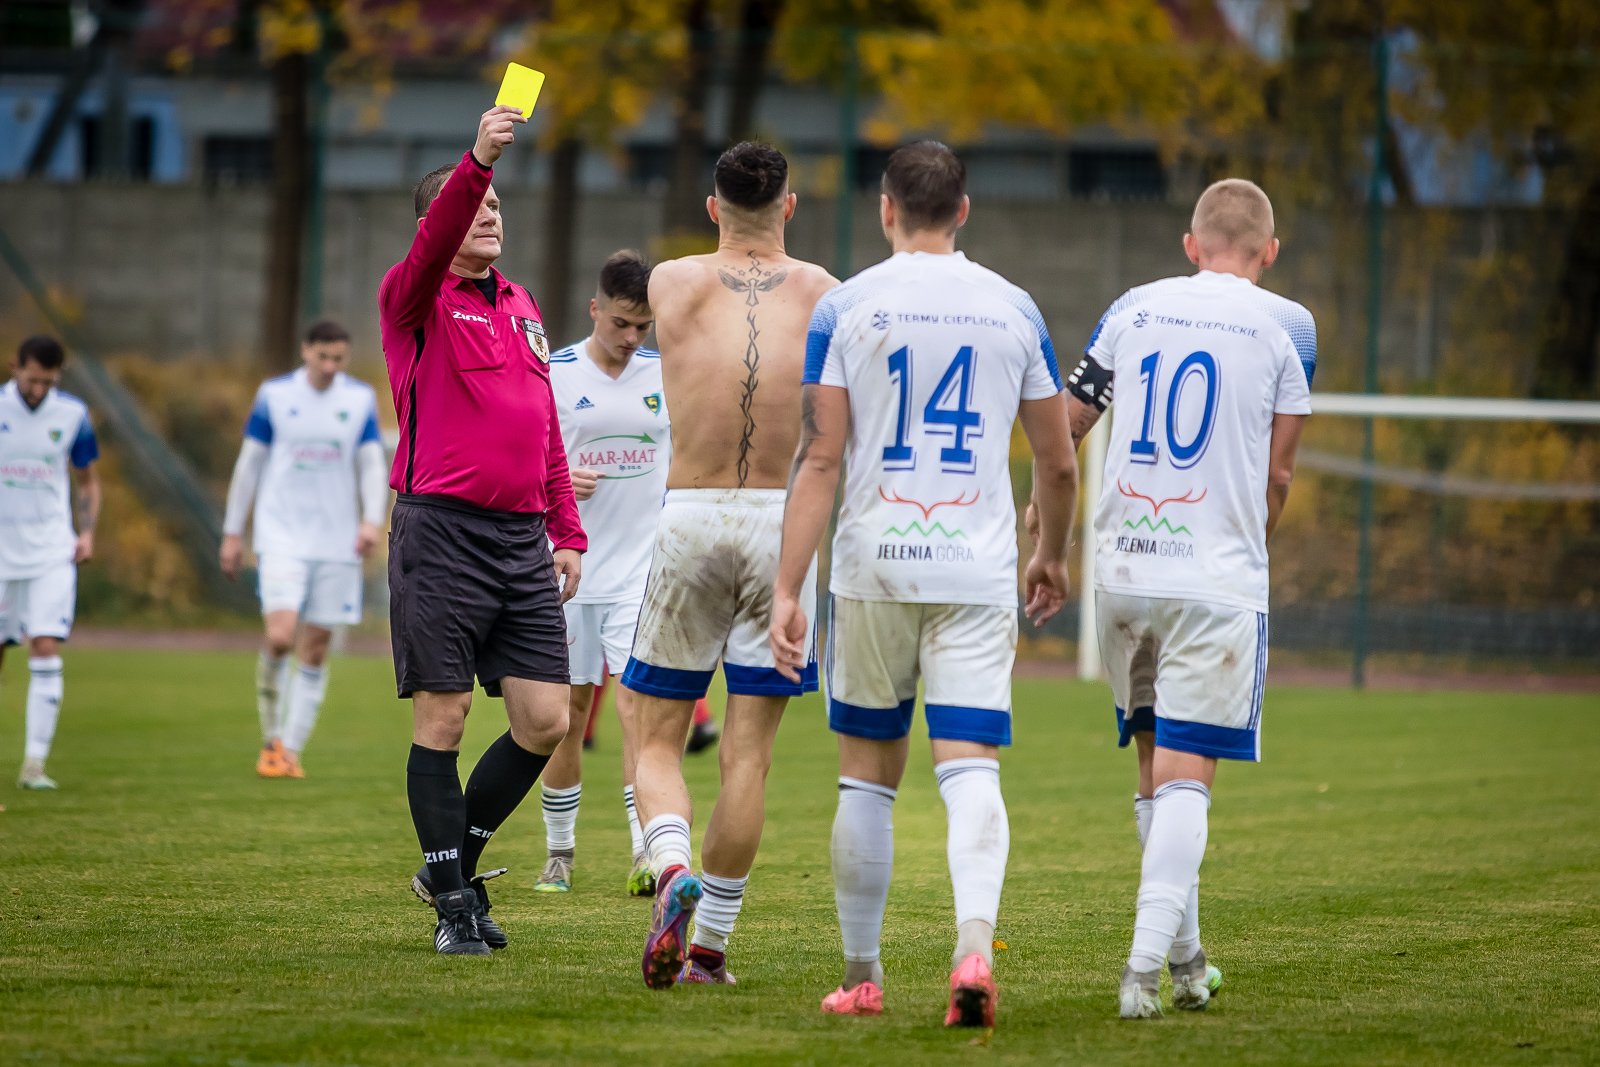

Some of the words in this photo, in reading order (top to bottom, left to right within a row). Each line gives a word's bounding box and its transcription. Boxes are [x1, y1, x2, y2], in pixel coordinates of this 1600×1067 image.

[897, 313, 939, 323] TERMY
[1155, 315, 1192, 327] TERMY
[1196, 321, 1259, 338] CIEPLICKIE
[882, 344, 985, 476] 14
[1130, 350, 1221, 471] 10
[579, 448, 656, 466] MAR-MAT
[877, 544, 932, 560] JELENIA
[1115, 537, 1157, 554] JELENIA
[469, 826, 494, 838] zin
[424, 848, 458, 864] zina
